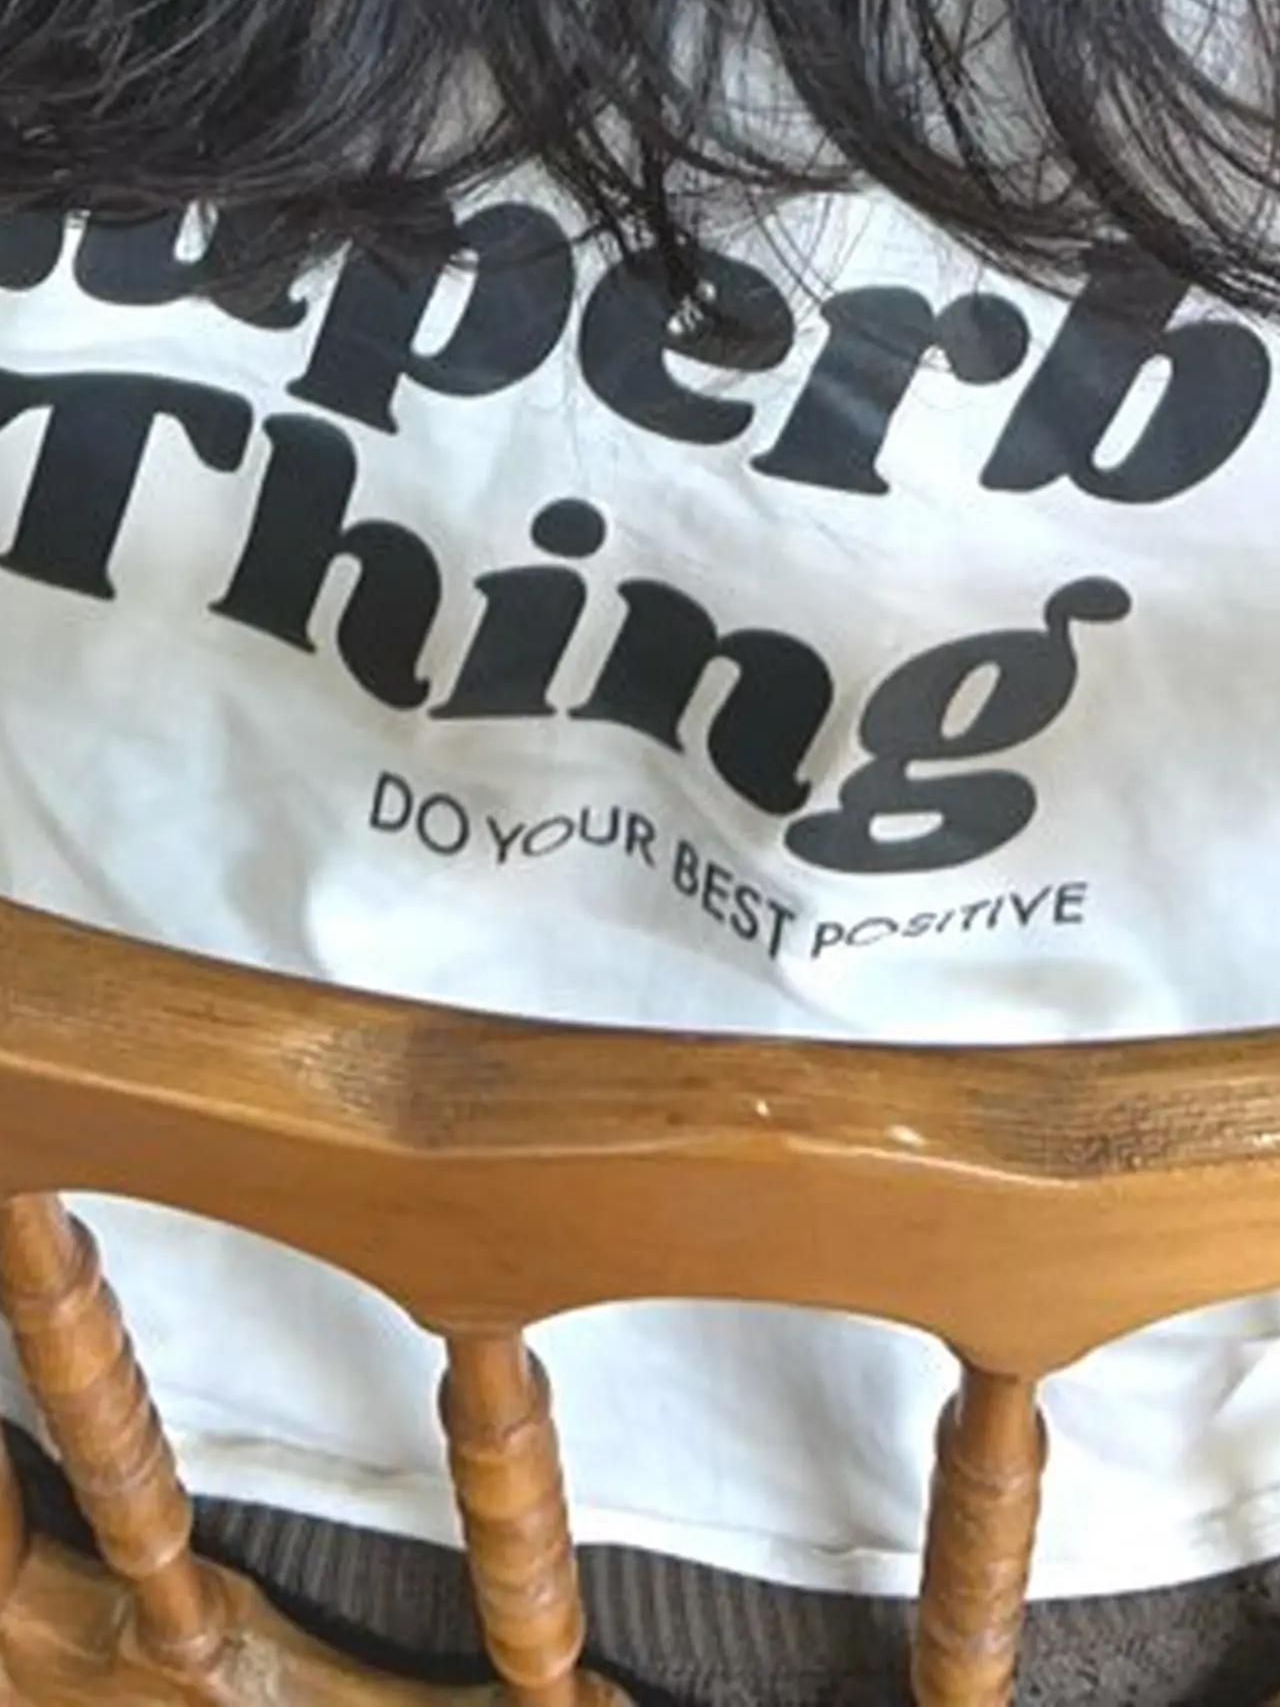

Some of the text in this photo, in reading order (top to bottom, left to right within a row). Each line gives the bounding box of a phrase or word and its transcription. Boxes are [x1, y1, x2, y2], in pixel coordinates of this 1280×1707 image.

[368, 771, 1088, 959] DO YOUR BEST POSITIVE
